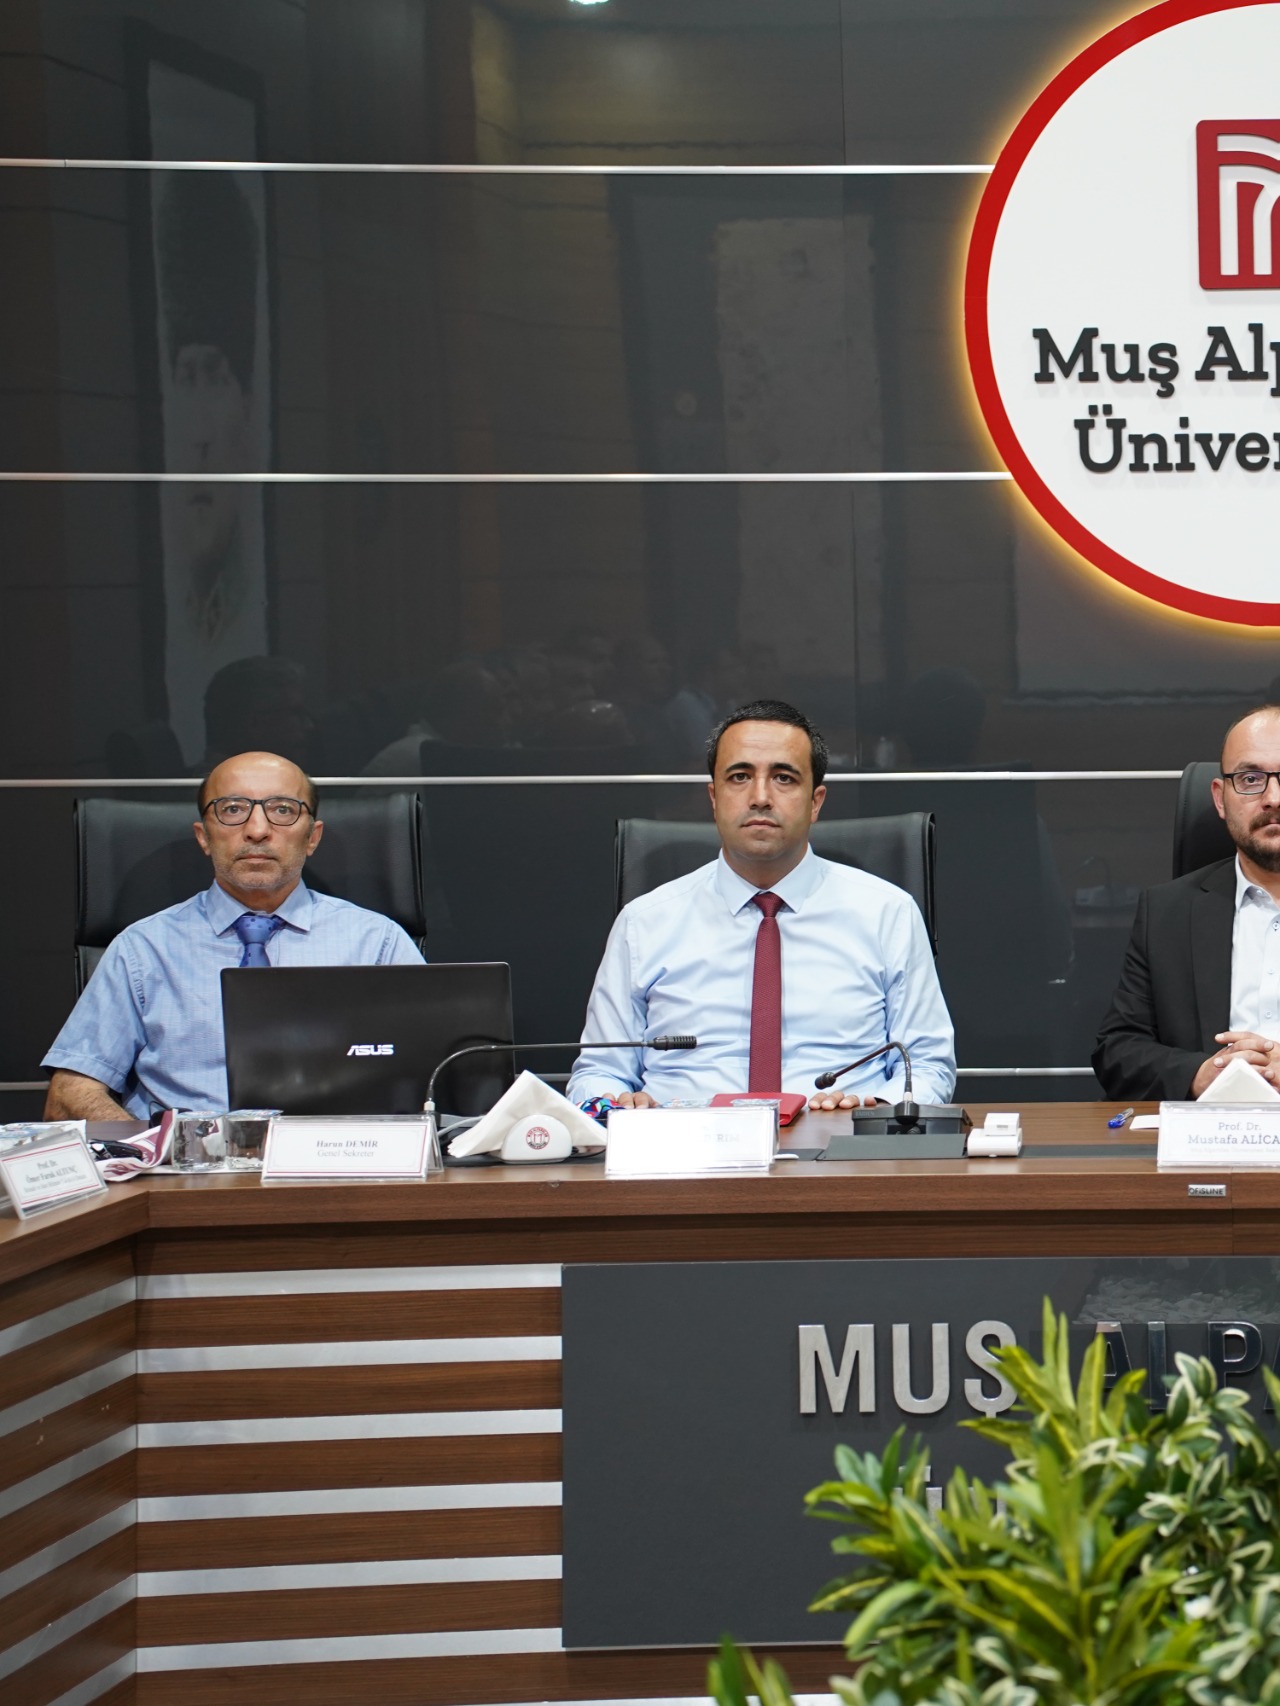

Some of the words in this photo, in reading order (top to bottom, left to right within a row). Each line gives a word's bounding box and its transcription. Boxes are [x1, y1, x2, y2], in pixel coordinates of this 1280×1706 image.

[1032, 327, 1179, 398] Muş
[346, 1044, 394, 1056] ASUS
[1218, 1121, 1243, 1131] Prof.
[1246, 1121, 1262, 1131] Dr.
[316, 1140, 343, 1148] Harun
[345, 1139, 379, 1148] DEMİR
[1187, 1134, 1238, 1145] Mustafa
[317, 1149, 341, 1158] Genel
[343, 1149, 375, 1158] Sekreter
[798, 1319, 1019, 1418] MUŞ
